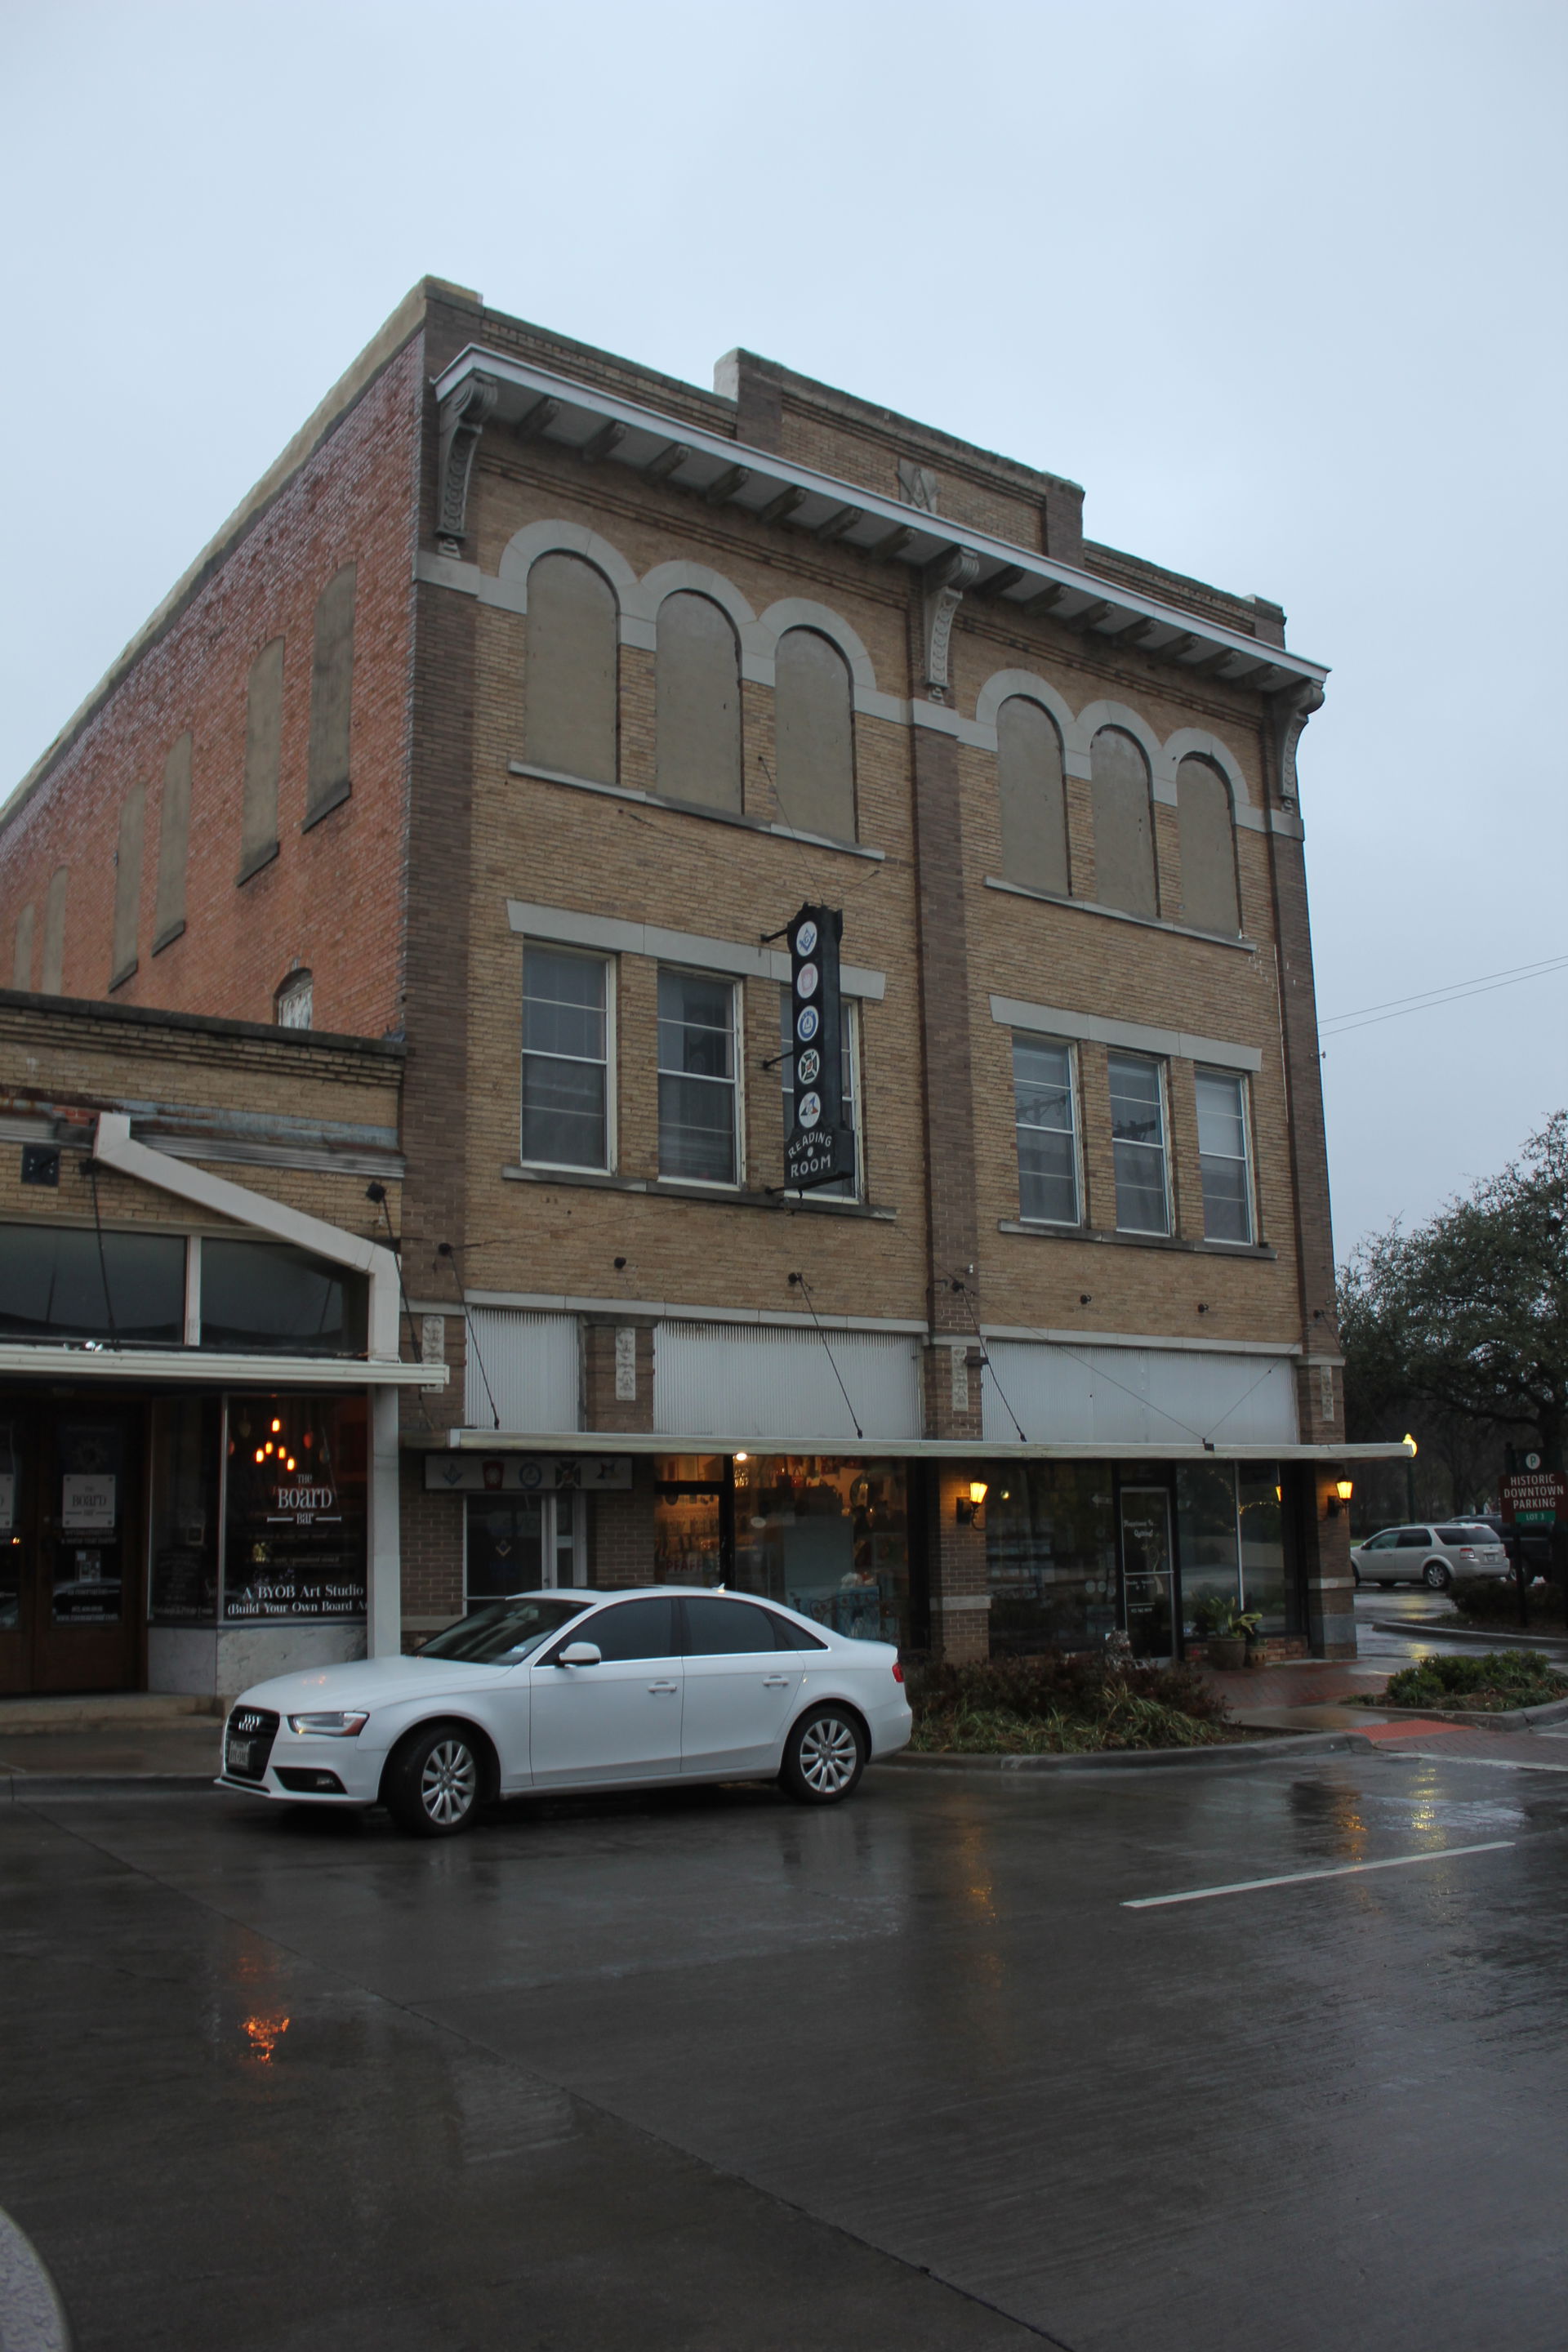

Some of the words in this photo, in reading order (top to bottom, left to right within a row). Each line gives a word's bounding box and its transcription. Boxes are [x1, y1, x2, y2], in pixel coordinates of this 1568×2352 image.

[788, 1131, 832, 1159] READING
[791, 1154, 831, 1178] ROOM
[1530, 1456, 1536, 1467] P
[1510, 1473, 1555, 1486] HISTORIC
[1503, 1485, 1564, 1499] DOWNTOWN
[1513, 1497, 1556, 1509] PARKING
[1526, 1512, 1538, 1521] LOT
[242, 1587, 252, 1600] A
[258, 1585, 296, 1600] BYOB
[300, 1585, 320, 1598] Art
[324, 1584, 364, 1597] Studio
[227, 1602, 260, 1615] (Build
[263, 1602, 288, 1614] Your
[292, 1601, 318, 1613] Own
[322, 1600, 353, 1612] Board
